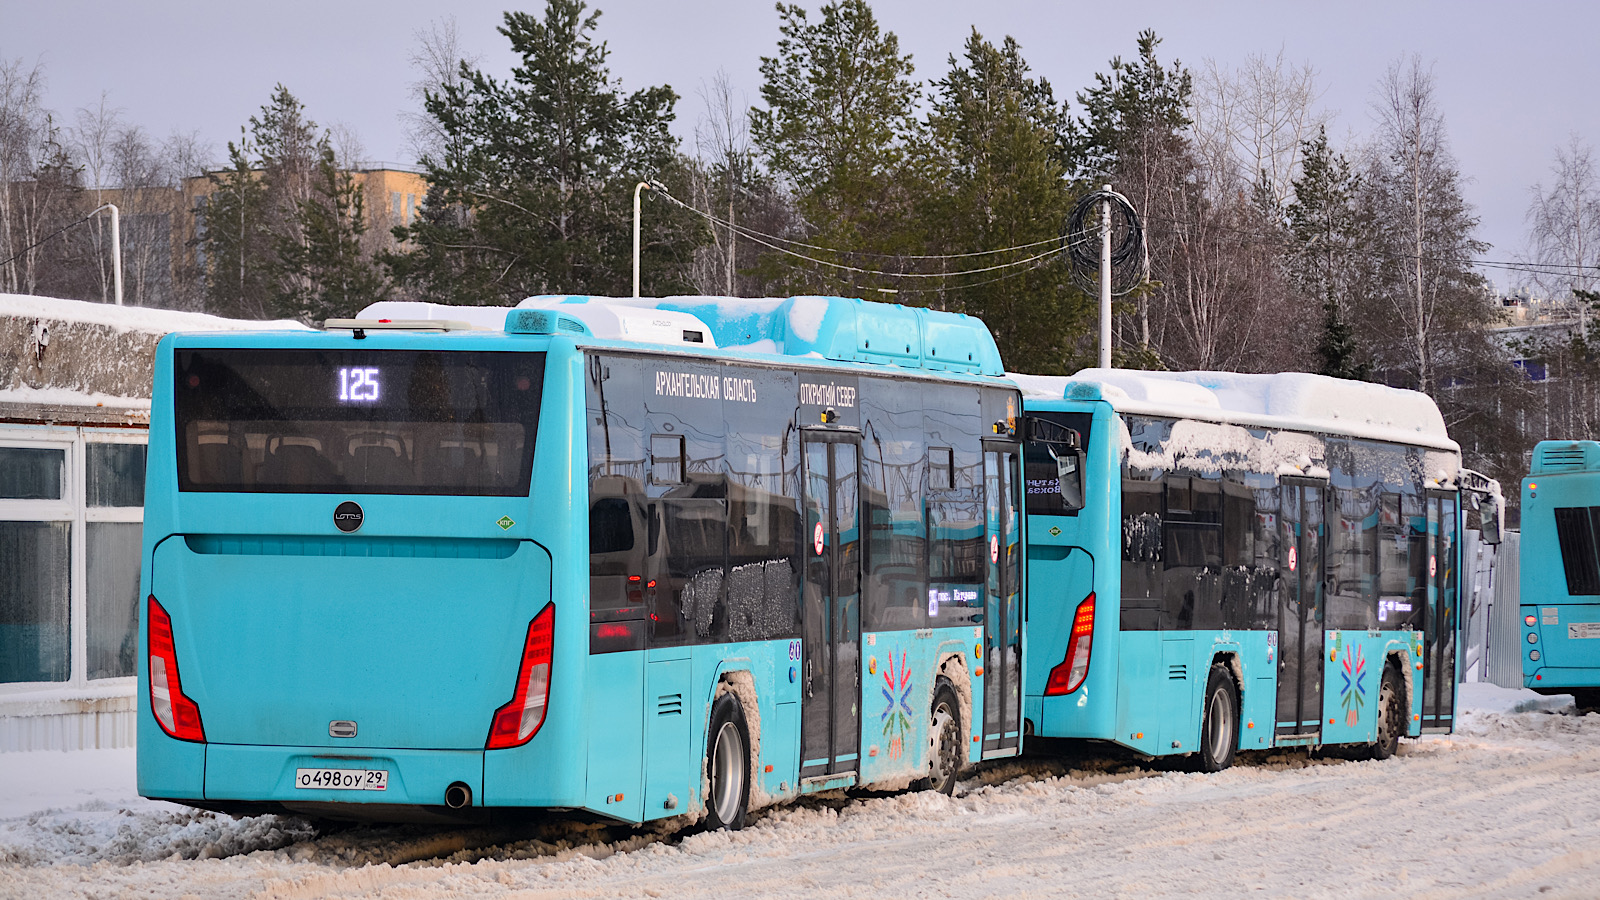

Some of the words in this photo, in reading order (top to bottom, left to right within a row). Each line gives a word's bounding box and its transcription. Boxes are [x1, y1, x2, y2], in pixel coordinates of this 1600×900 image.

[340, 368, 379, 400] 125
[655, 371, 720, 399] АРХАНГЕЛЬСКАЯ
[723, 377, 757, 402] ОБЛАСТЬ
[800, 381, 836, 406] ОТКРЫТЫЙ
[836, 385, 856, 408] СЕВЕР
[366, 772, 383, 784] 29
